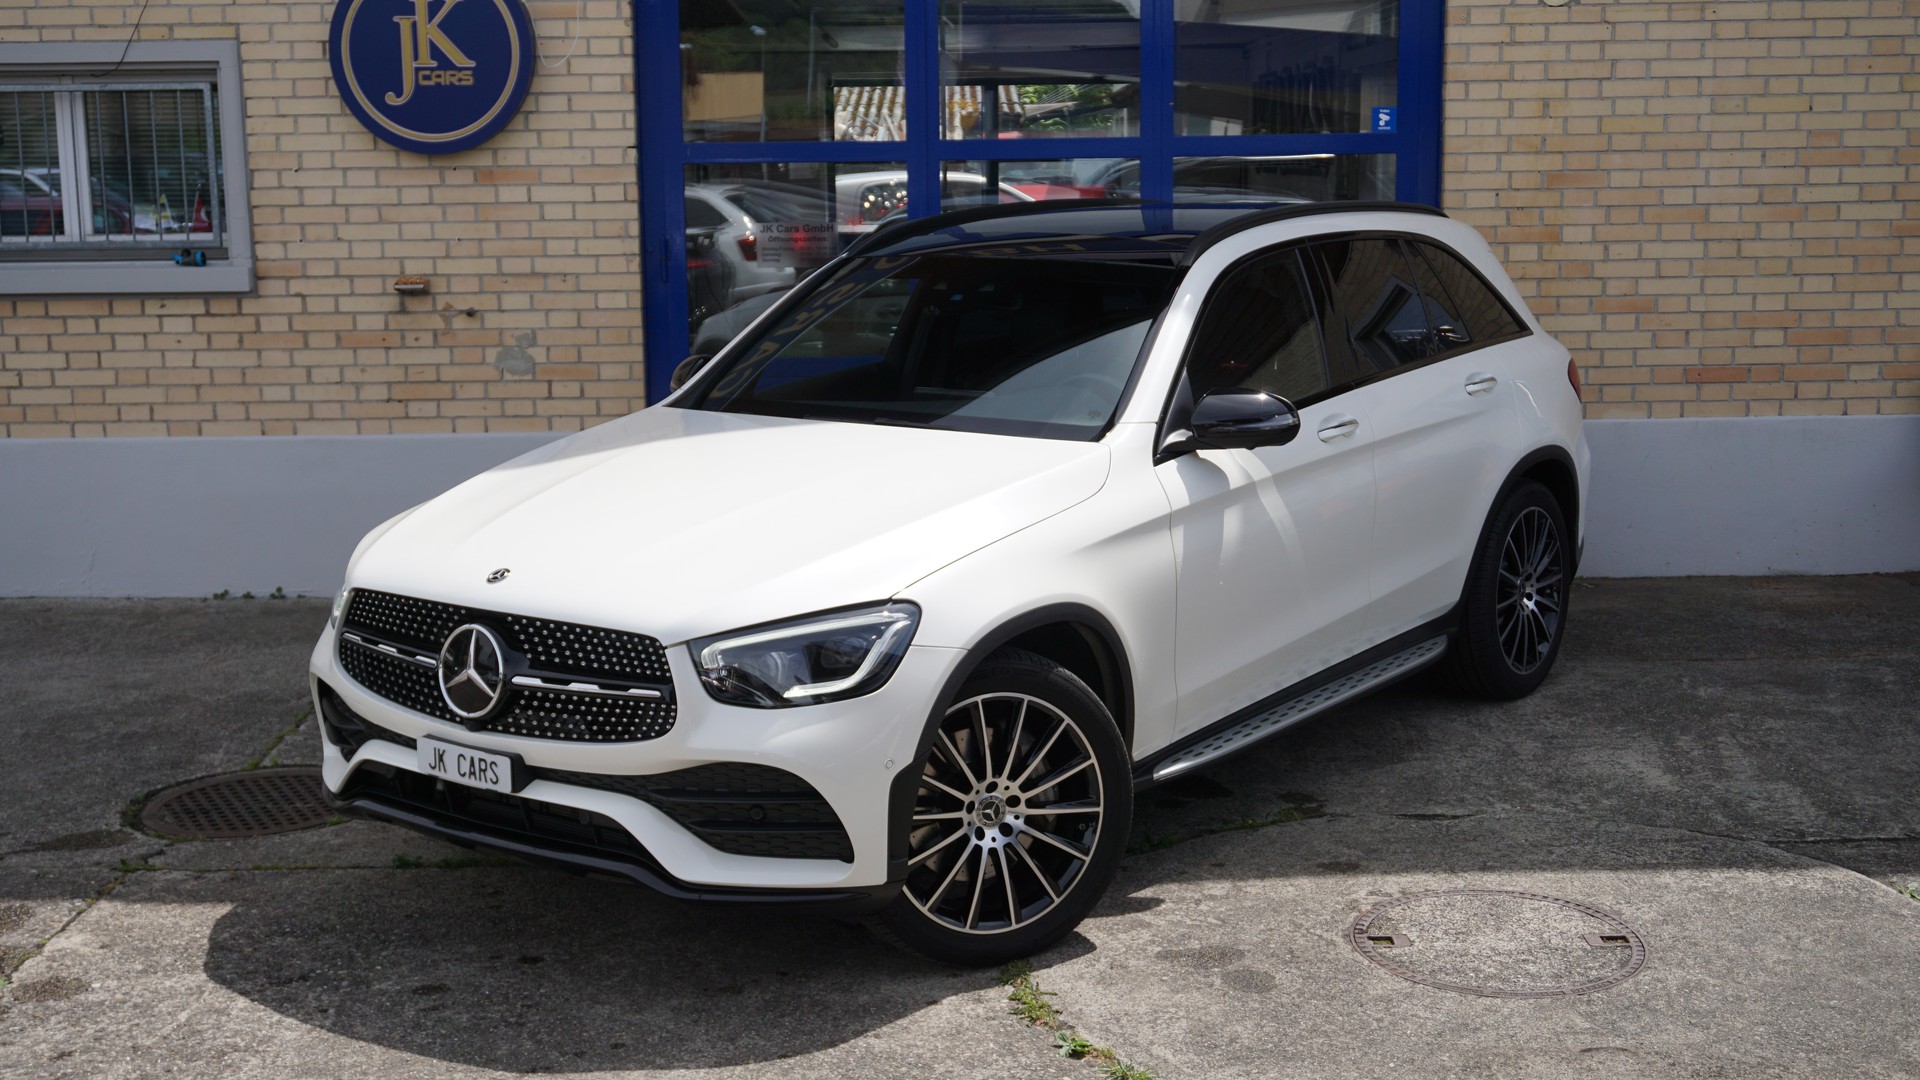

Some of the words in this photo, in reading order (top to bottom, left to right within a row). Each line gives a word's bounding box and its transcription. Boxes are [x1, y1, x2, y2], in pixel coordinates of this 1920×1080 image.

[385, 0, 476, 105] JK
[419, 70, 474, 86] CARS
[760, 224, 774, 233] JK
[776, 224, 800, 233] Cars
[802, 224, 834, 233] GmbH
[428, 747, 447, 774] JK
[457, 753, 499, 785] CARS
